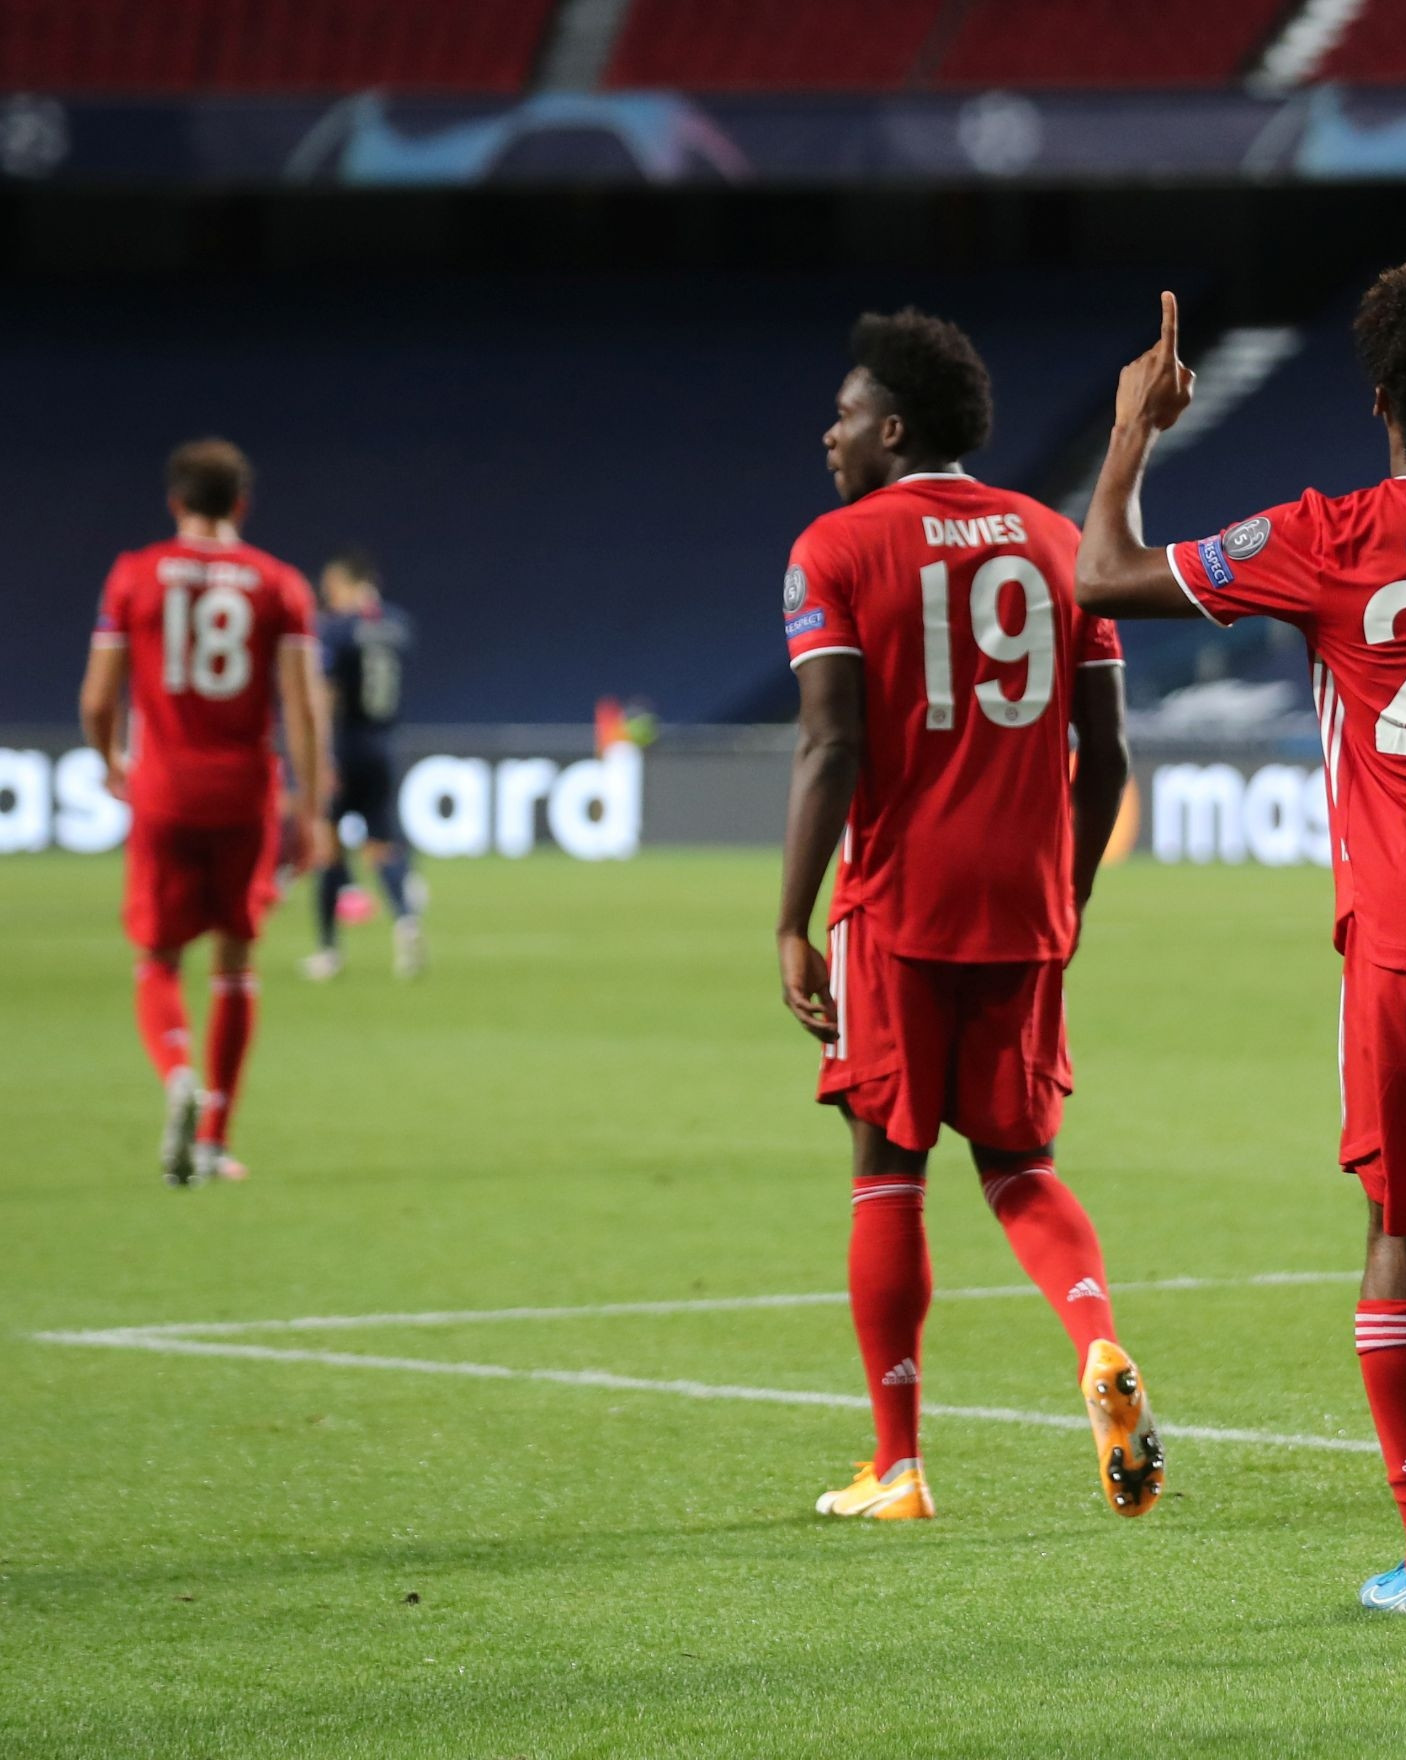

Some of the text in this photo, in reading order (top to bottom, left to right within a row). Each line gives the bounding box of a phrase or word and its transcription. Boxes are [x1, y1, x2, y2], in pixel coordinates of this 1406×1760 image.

[922, 514, 1027, 547] DAVIES
[163, 586, 255, 700] 18
[920, 555, 1054, 730] 19
